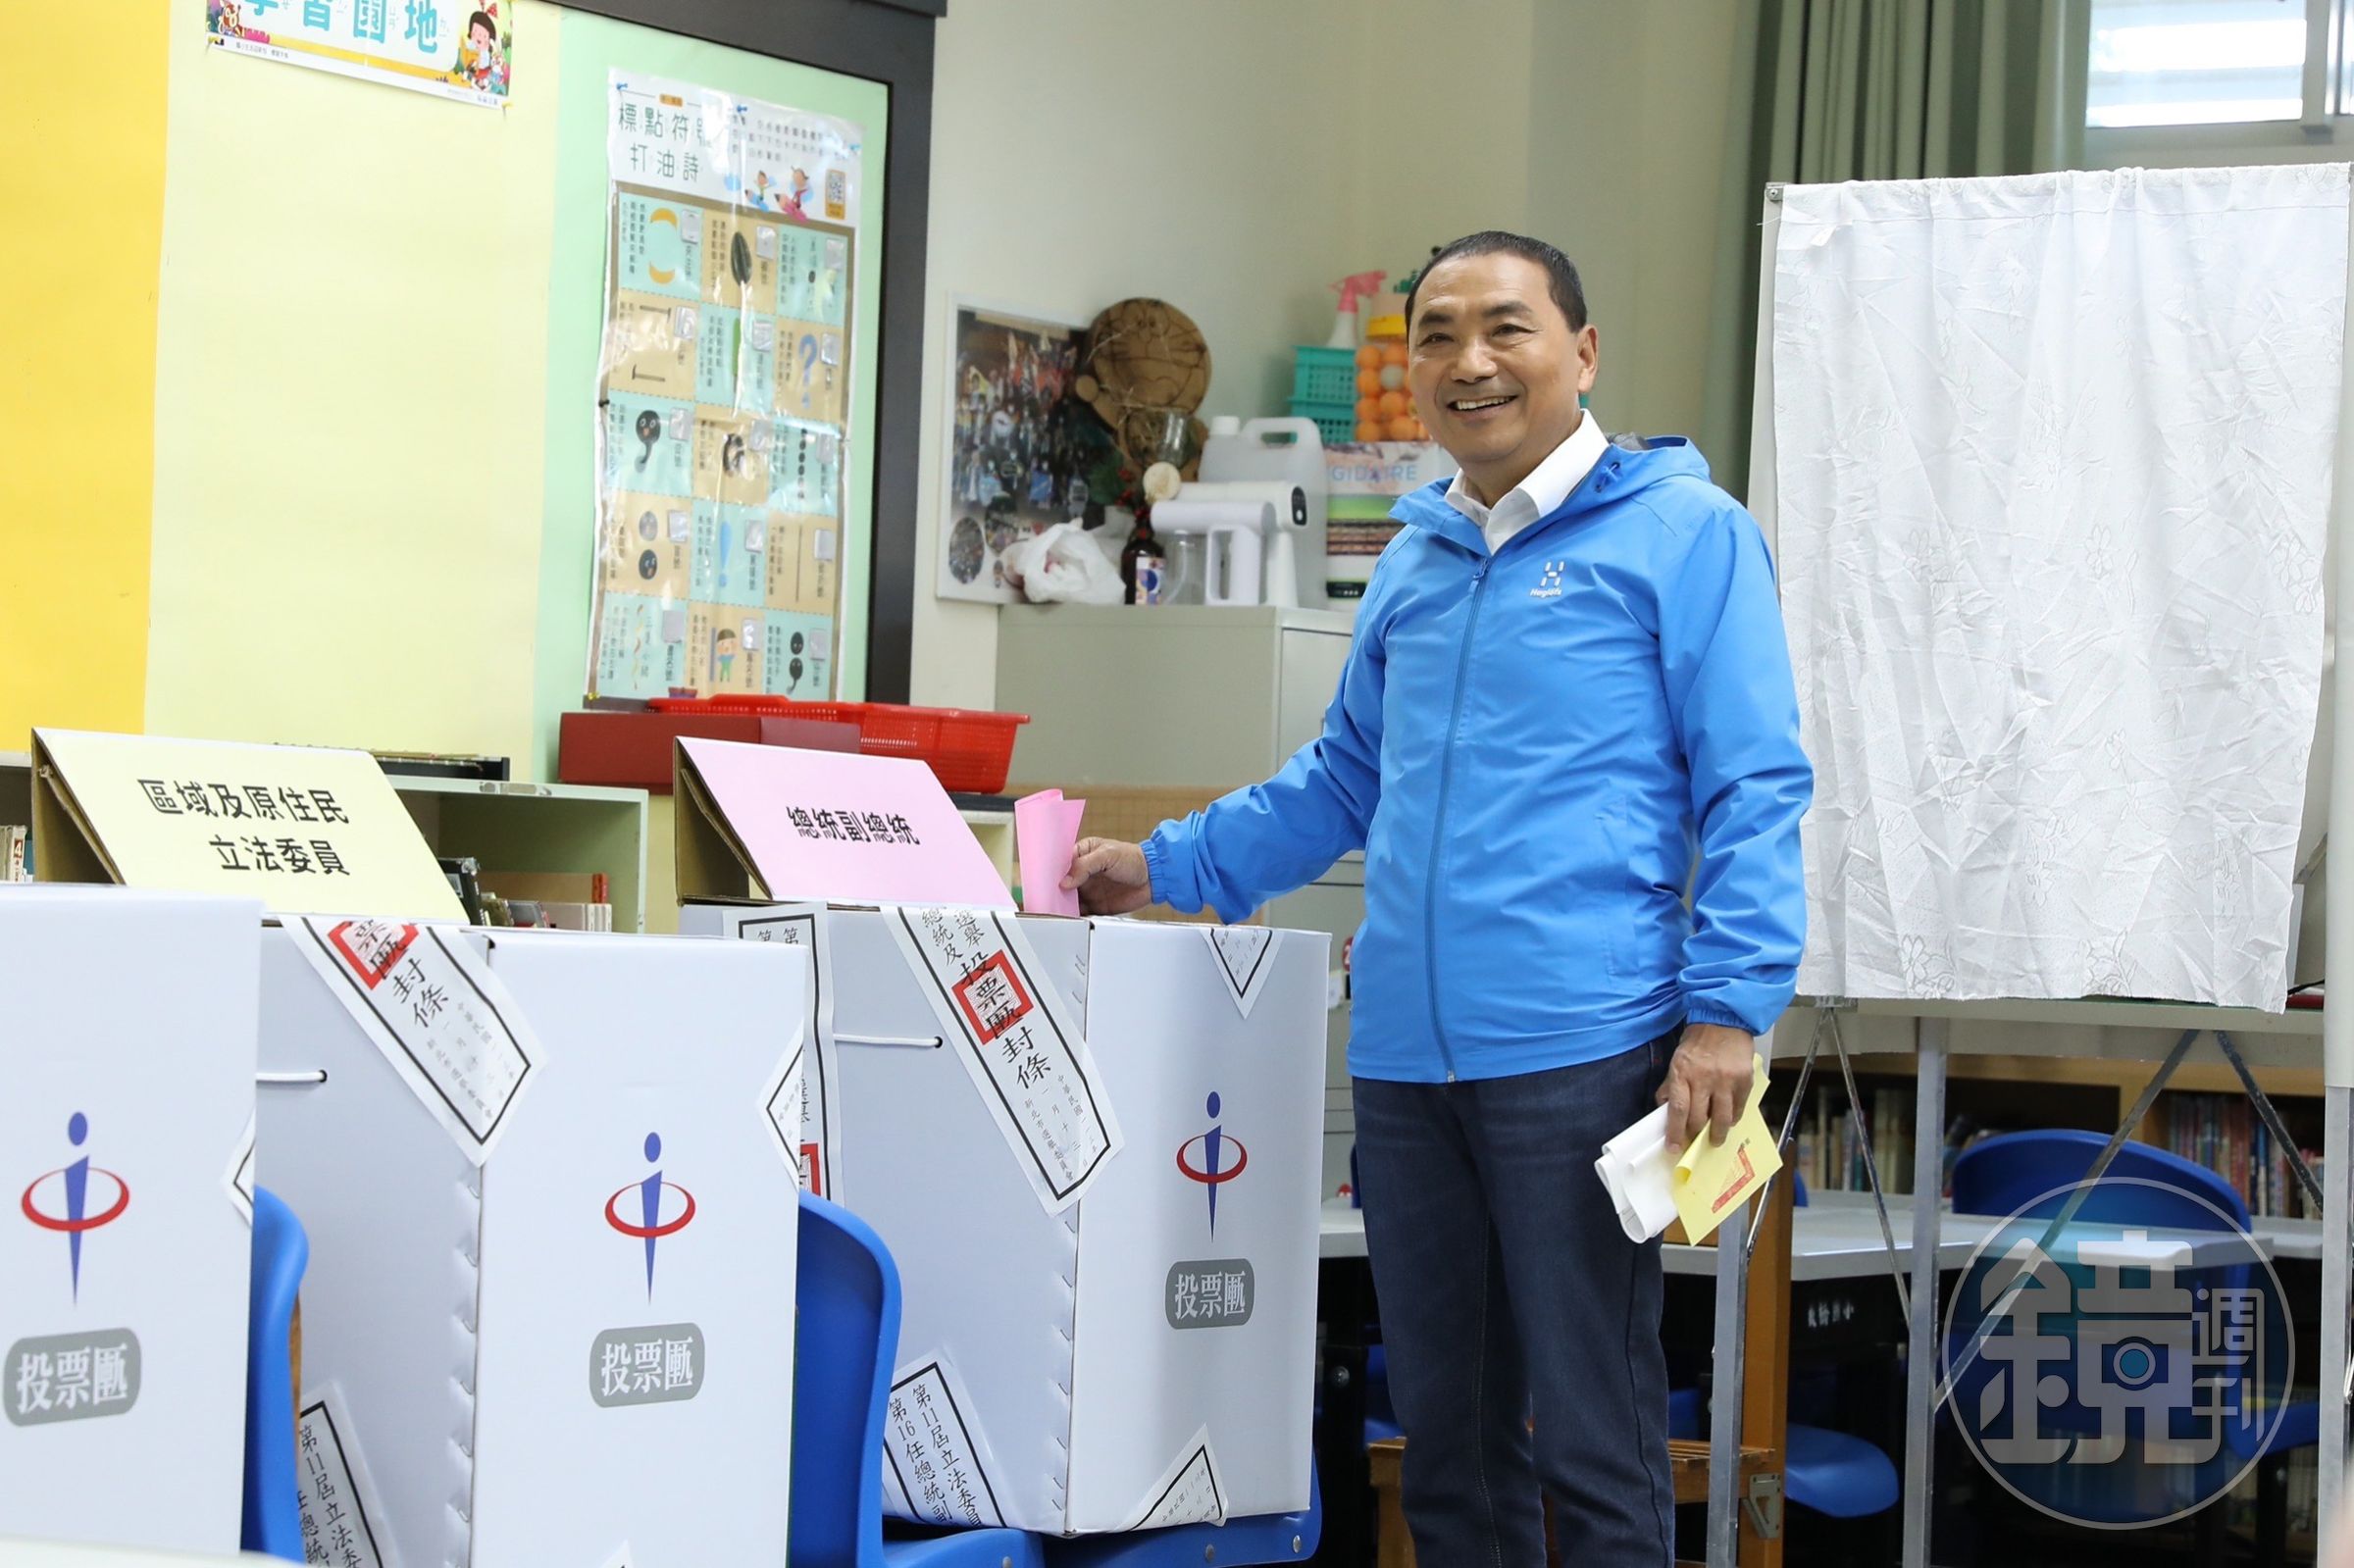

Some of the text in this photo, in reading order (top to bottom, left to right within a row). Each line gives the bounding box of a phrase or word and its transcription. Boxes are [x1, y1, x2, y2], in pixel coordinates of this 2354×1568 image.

[631, 142, 698, 182] 打油詩
[137, 779, 350, 825] 區域及原住民
[786, 806, 921, 846] 總統副總統
[209, 835, 351, 877] 立法委員
[1174, 1270, 1246, 1320] 投票匭
[16, 1342, 128, 1415] 投票匭
[600, 1337, 694, 1396] 投票匭
